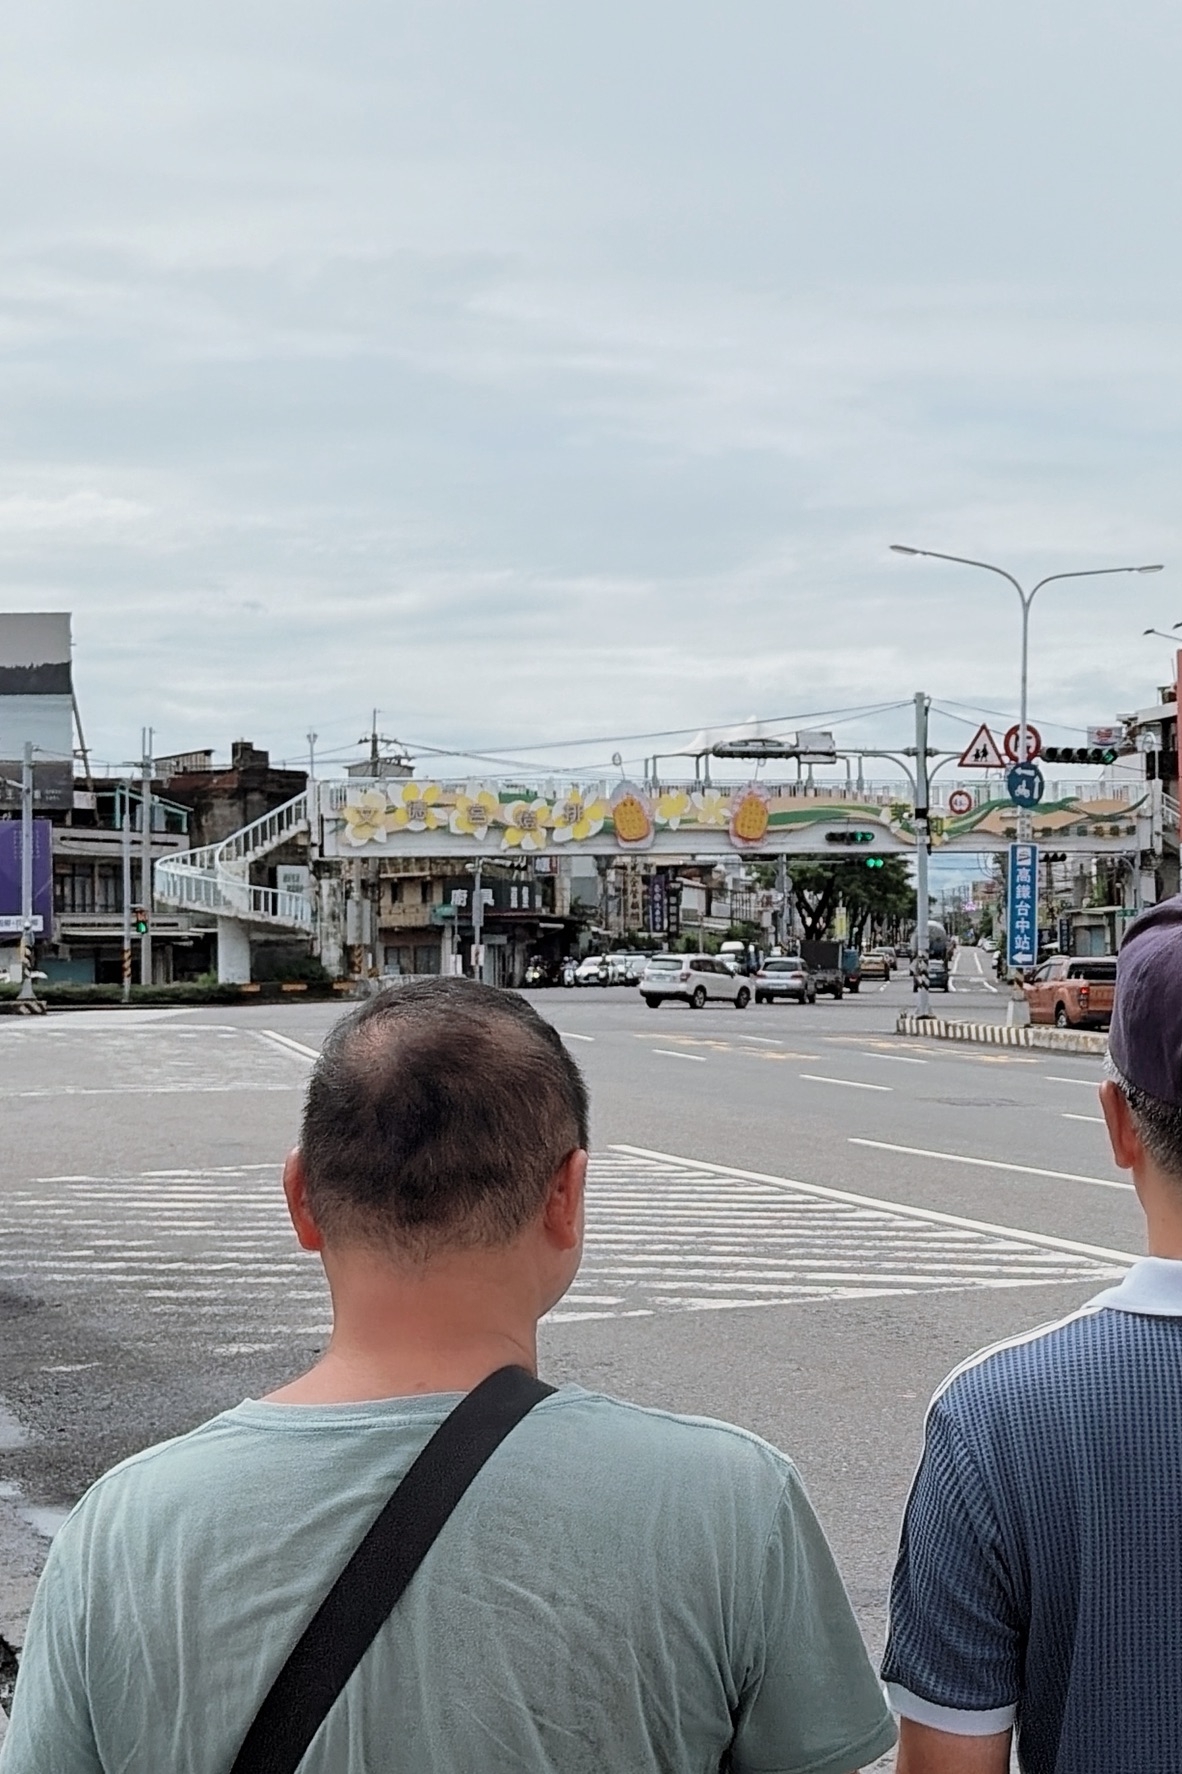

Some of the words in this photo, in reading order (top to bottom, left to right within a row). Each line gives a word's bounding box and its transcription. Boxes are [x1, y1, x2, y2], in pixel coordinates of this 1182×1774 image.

[1014, 867, 1032, 951] 高鐵台中站
